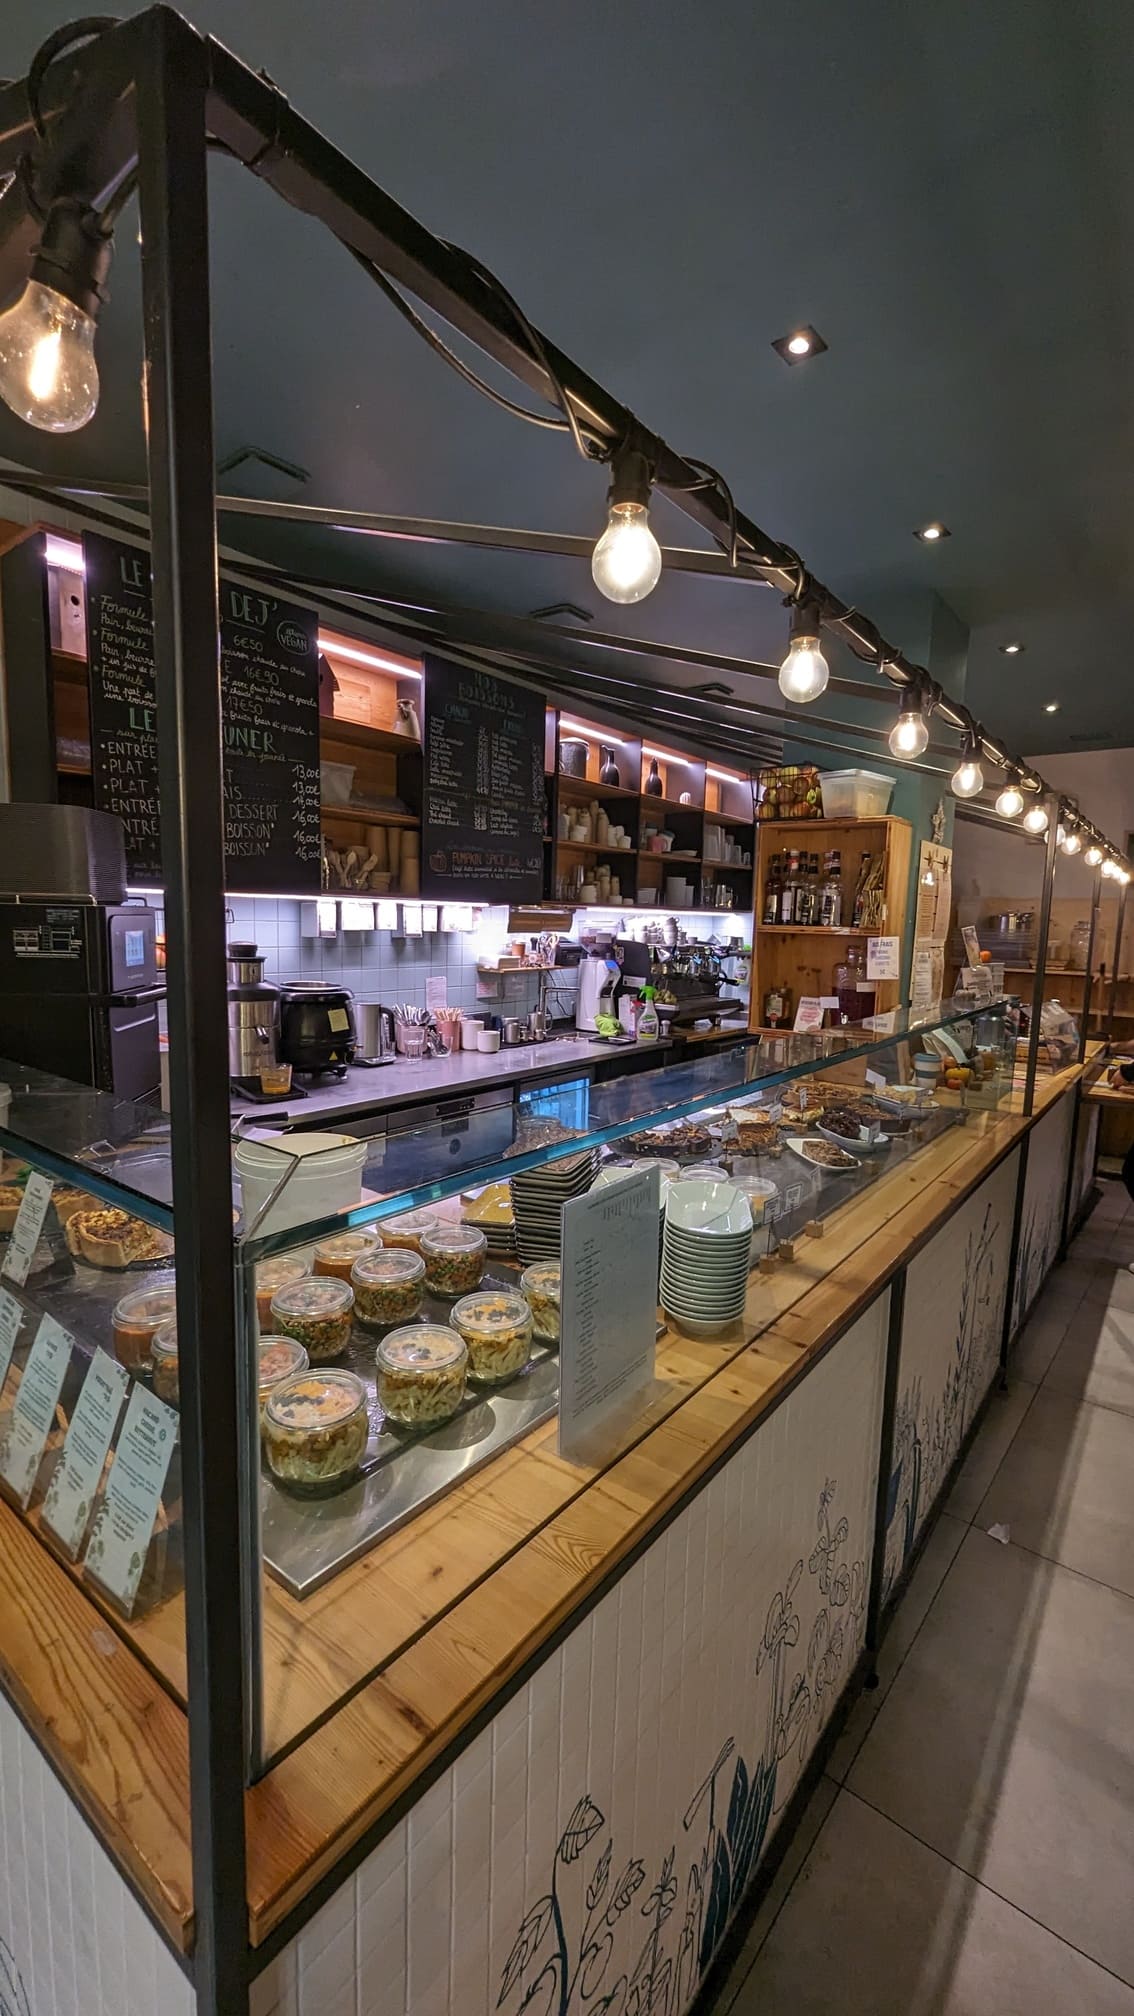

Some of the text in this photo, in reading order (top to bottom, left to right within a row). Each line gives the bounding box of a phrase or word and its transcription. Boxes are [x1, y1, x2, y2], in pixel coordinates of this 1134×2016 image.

[120, 555, 144, 588] LE
[100, 594, 264, 653] Formule 6€50
[100, 627, 150, 652] Formule
[281, 634, 307, 651] VEGAN
[101, 664, 148, 688] Formule
[232, 680, 249, 691] avec
[102, 679, 121, 694] Une
[129, 707, 156, 733] LE
[107, 740, 158, 760] ENTRÉE
[109, 758, 144, 776] PLAT
[110, 777, 150, 795] PLAT
[229, 803, 280, 822] DESSERT
[121, 819, 160, 837] NTRÉ
